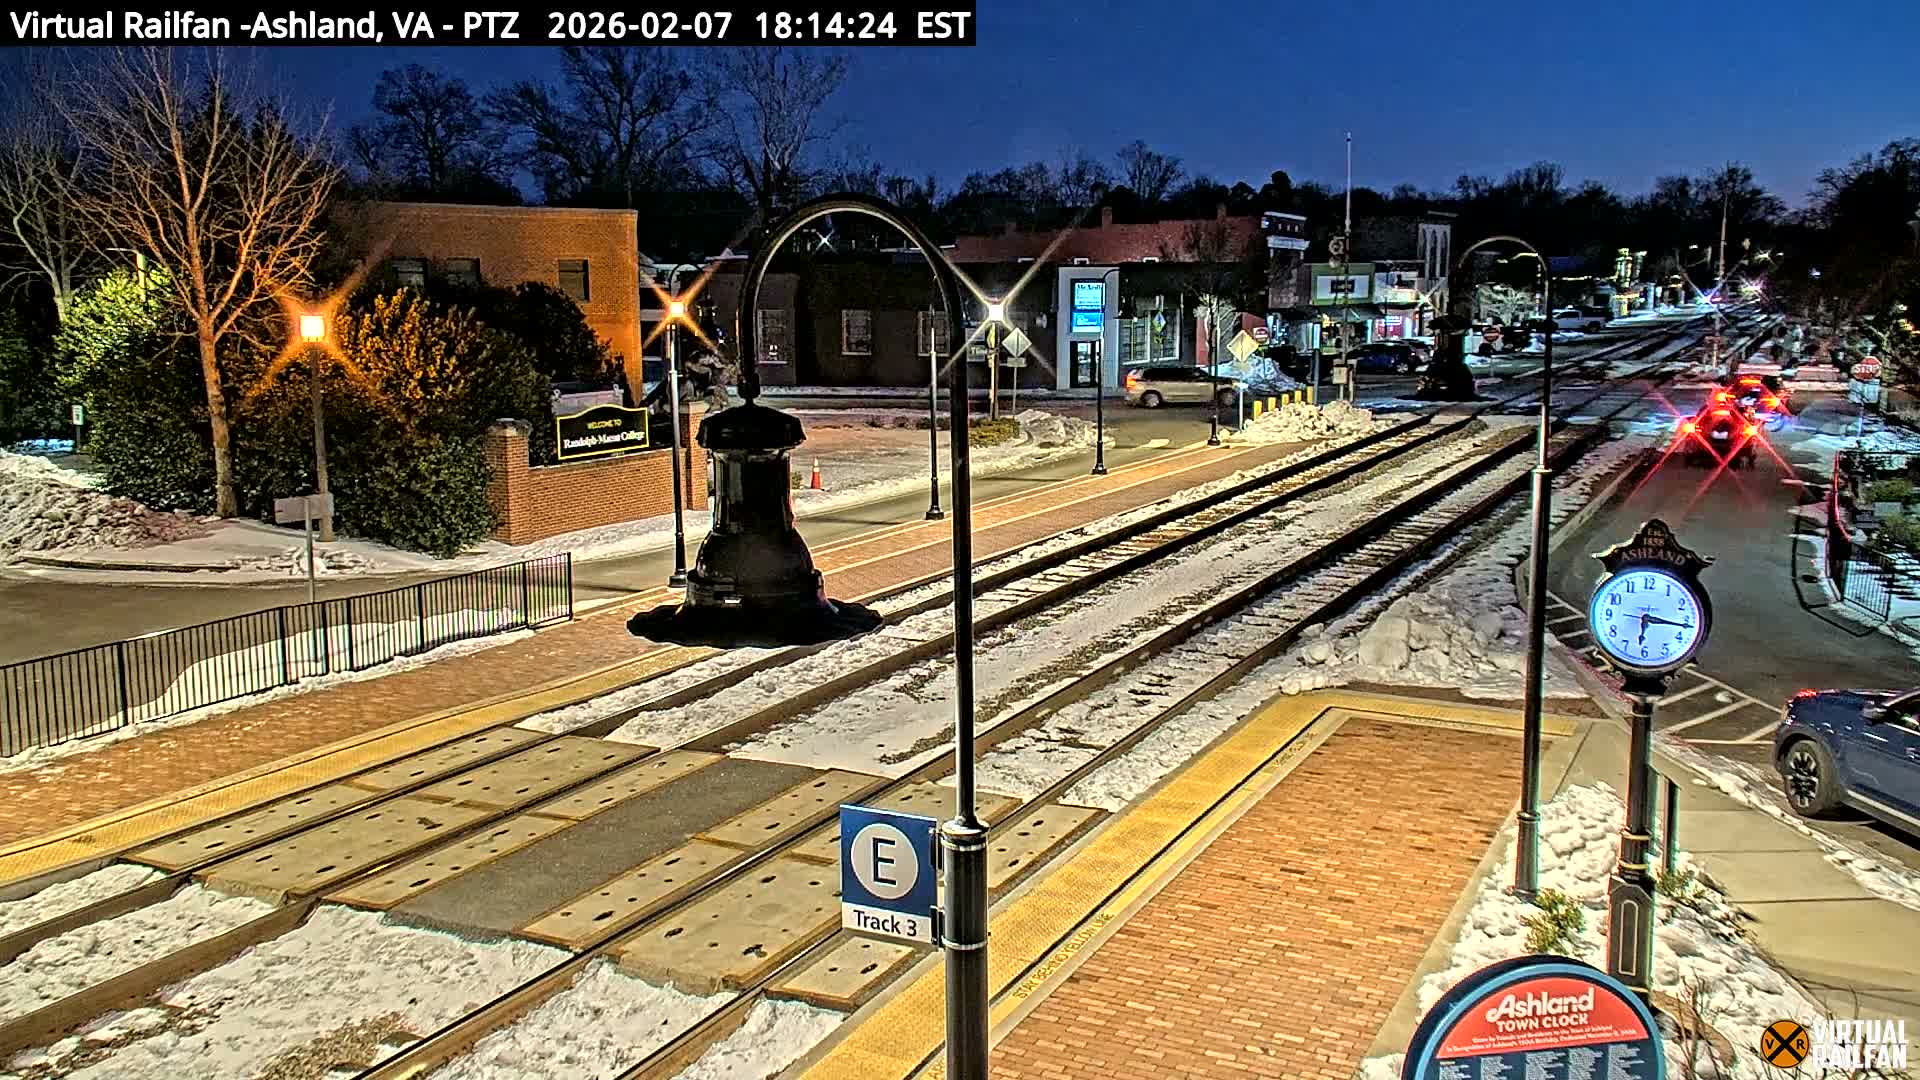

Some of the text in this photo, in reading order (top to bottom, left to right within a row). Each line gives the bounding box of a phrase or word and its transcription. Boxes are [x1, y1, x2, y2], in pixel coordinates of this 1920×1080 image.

[620, 430, 645, 441] College
[1621, 548, 1685, 565] ASHLAND
[1626, 581, 1635, 593] 11
[1644, 577, 1656, 590] 12
[1665, 585, 1671, 597] 1
[1609, 593, 1622, 606] 10
[1678, 598, 1686, 610] 2
[1605, 609, 1613, 621] 9
[1609, 625, 1617, 638] 8
[1675, 631, 1684, 643] 4
[1622, 640, 1630, 652] 7
[1641, 646, 1649, 658] 6
[1661, 643, 1670, 656] 5
[872, 837, 896, 885] E
[853, 909, 917, 937] Track 3
[1485, 987, 1595, 1023] Ashland
[1496, 1013, 1589, 1033] TOWN CLOCK
